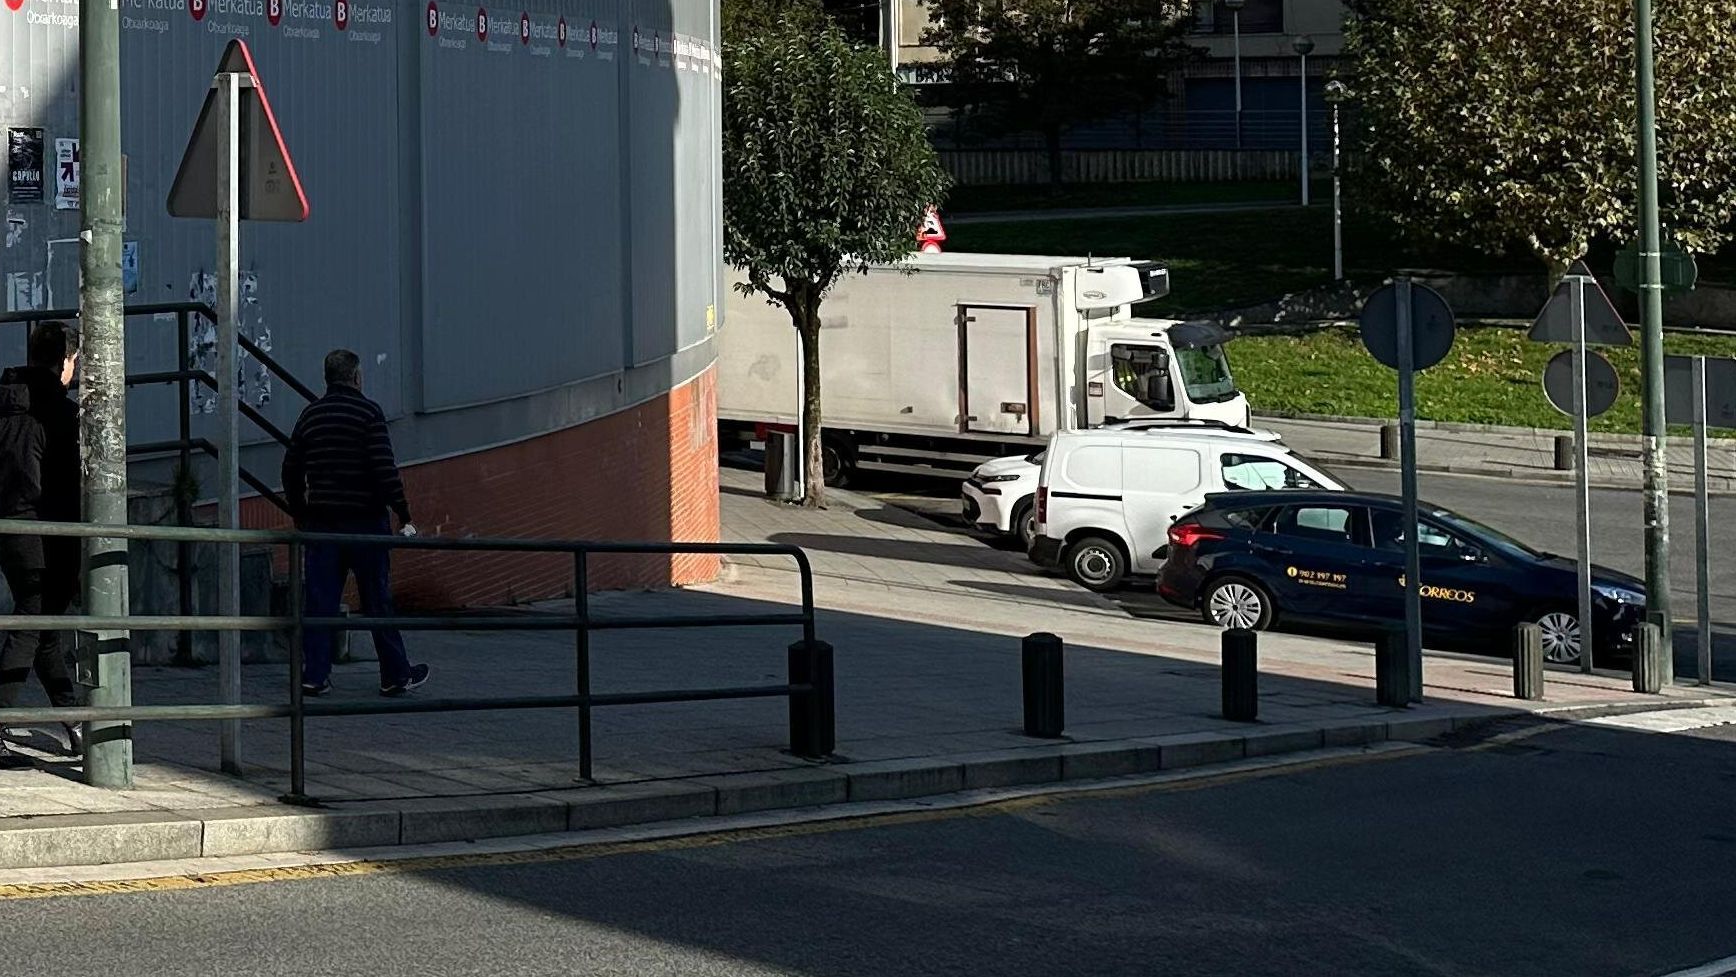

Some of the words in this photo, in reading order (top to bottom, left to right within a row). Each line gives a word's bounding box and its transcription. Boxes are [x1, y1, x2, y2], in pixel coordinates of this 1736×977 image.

[337, 2, 346, 22] B
[349, 3, 392, 24] Merkatua
[429, 9, 437, 28] B
[479, 15, 486, 33] B
[1419, 585, 1476, 603] ORREOS
